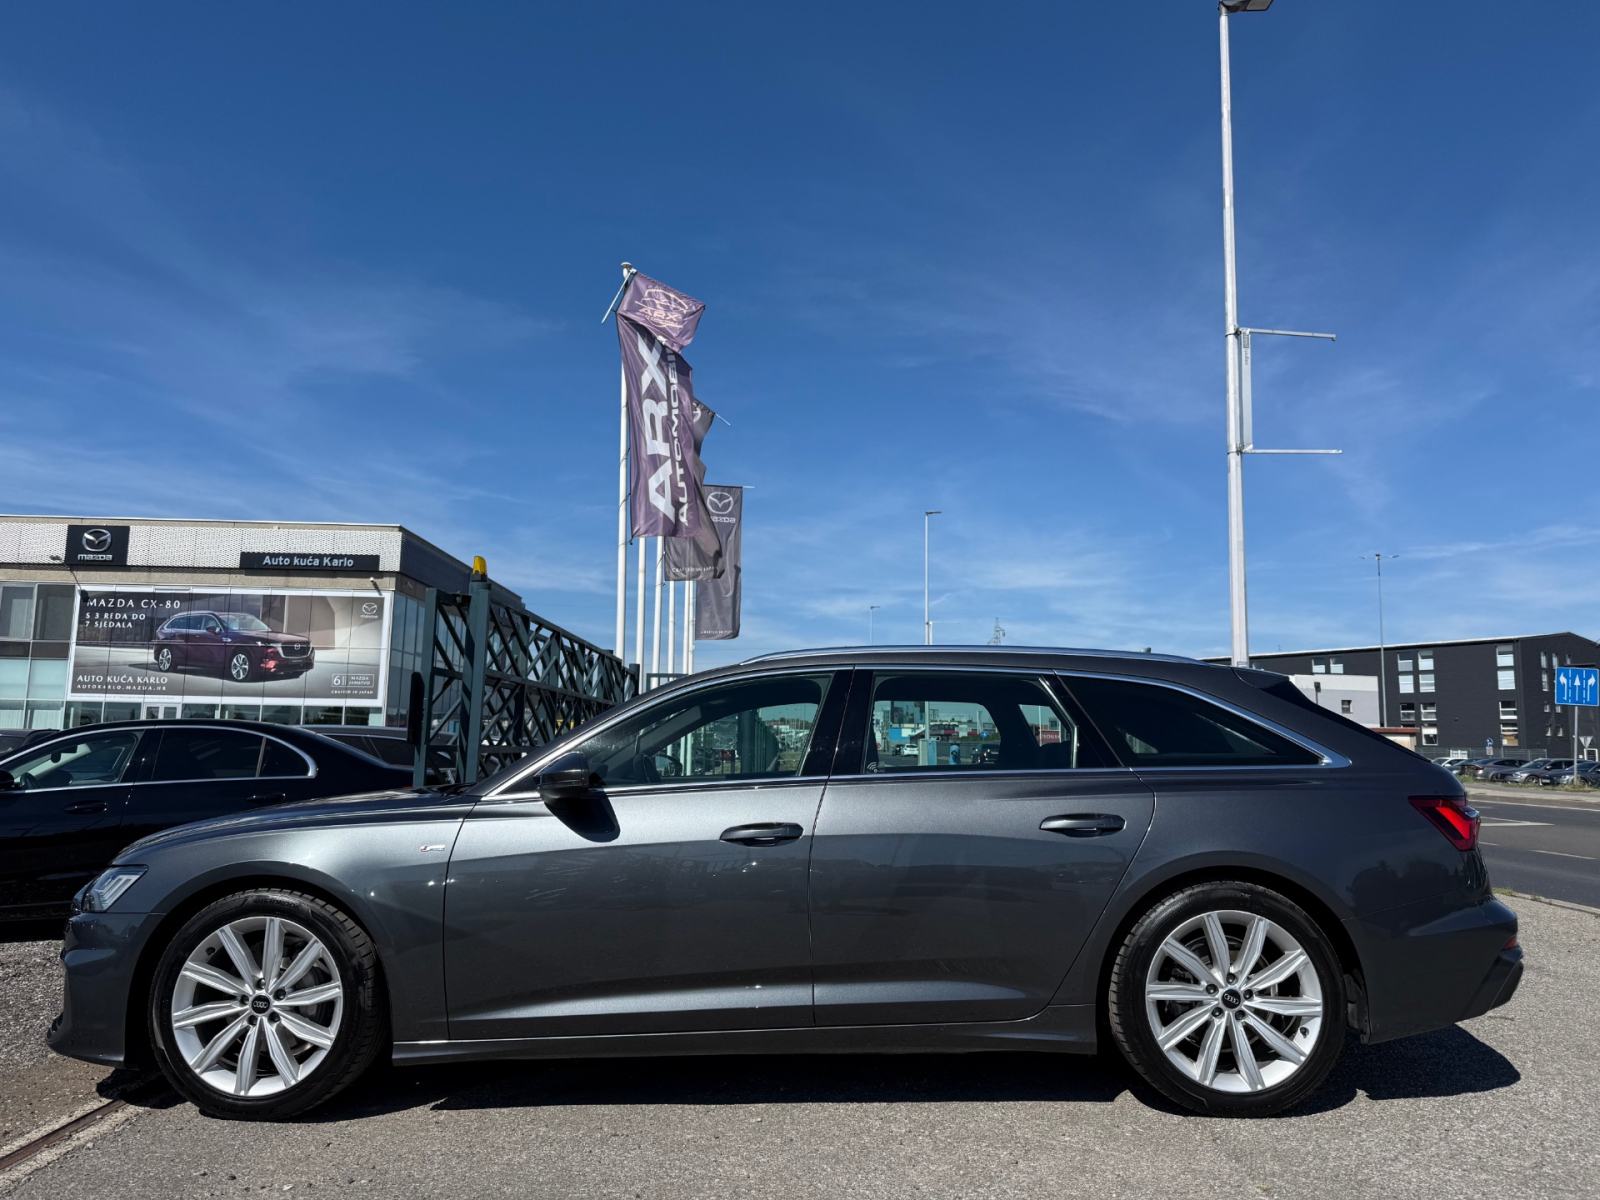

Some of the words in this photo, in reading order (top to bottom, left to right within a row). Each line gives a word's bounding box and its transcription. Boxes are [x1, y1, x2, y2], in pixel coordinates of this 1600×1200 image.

[637, 332, 675, 524] ARX
[262, 555, 291, 566] Auto
[293, 556, 320, 566] kuća
[323, 556, 354, 567] Karlo
[87, 598, 135, 608] MAZDA
[140, 599, 181, 609] CX-80
[94, 612, 100, 620] 3
[103, 612, 128, 620] REDA
[131, 613, 146, 621] DO
[93, 621, 133, 629] SJEDALA
[76, 674, 104, 683] AUTO
[106, 674, 134, 684] KUĆA
[137, 675, 168, 685] KARLO
[333, 675, 341, 686] 6
